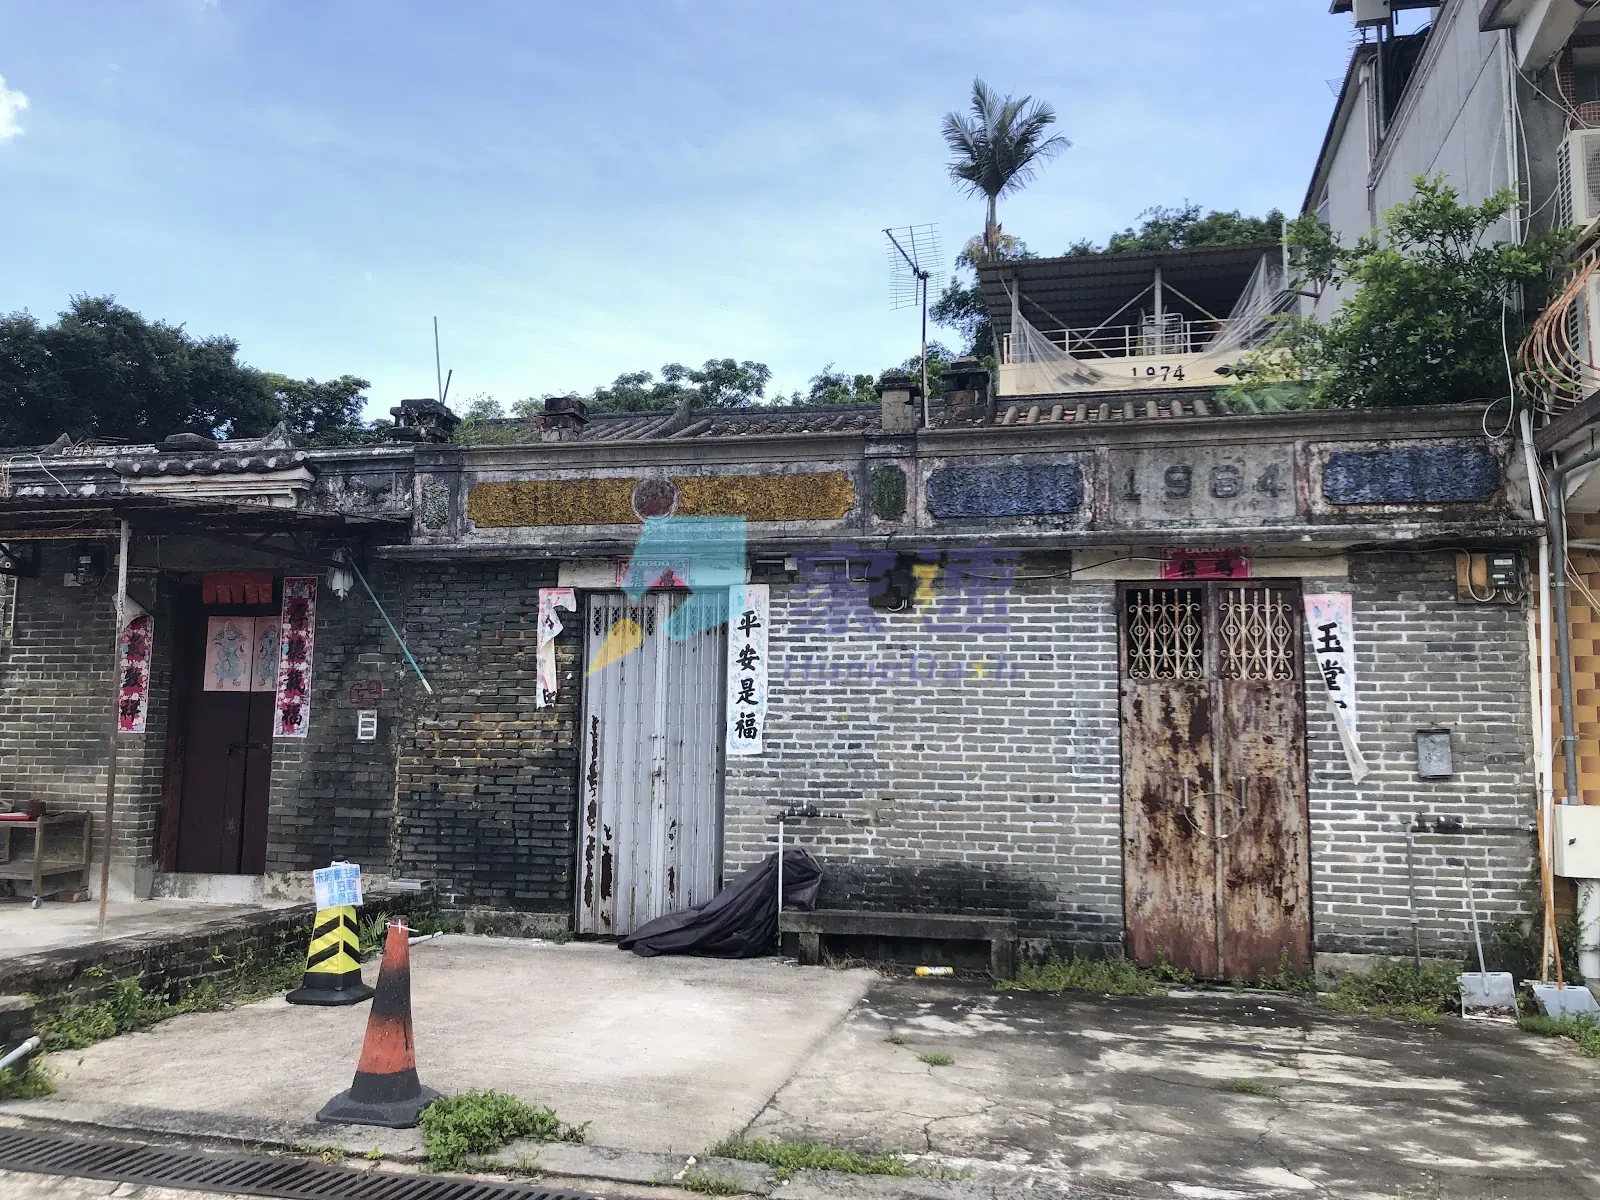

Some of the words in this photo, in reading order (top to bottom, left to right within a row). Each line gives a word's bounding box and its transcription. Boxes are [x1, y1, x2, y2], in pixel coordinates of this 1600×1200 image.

[1131, 365, 1185, 382] 1974
[1122, 463, 1287, 501] 1964
[734, 609, 762, 740] 平安是福
[1316, 621, 1348, 709] 玉堂
